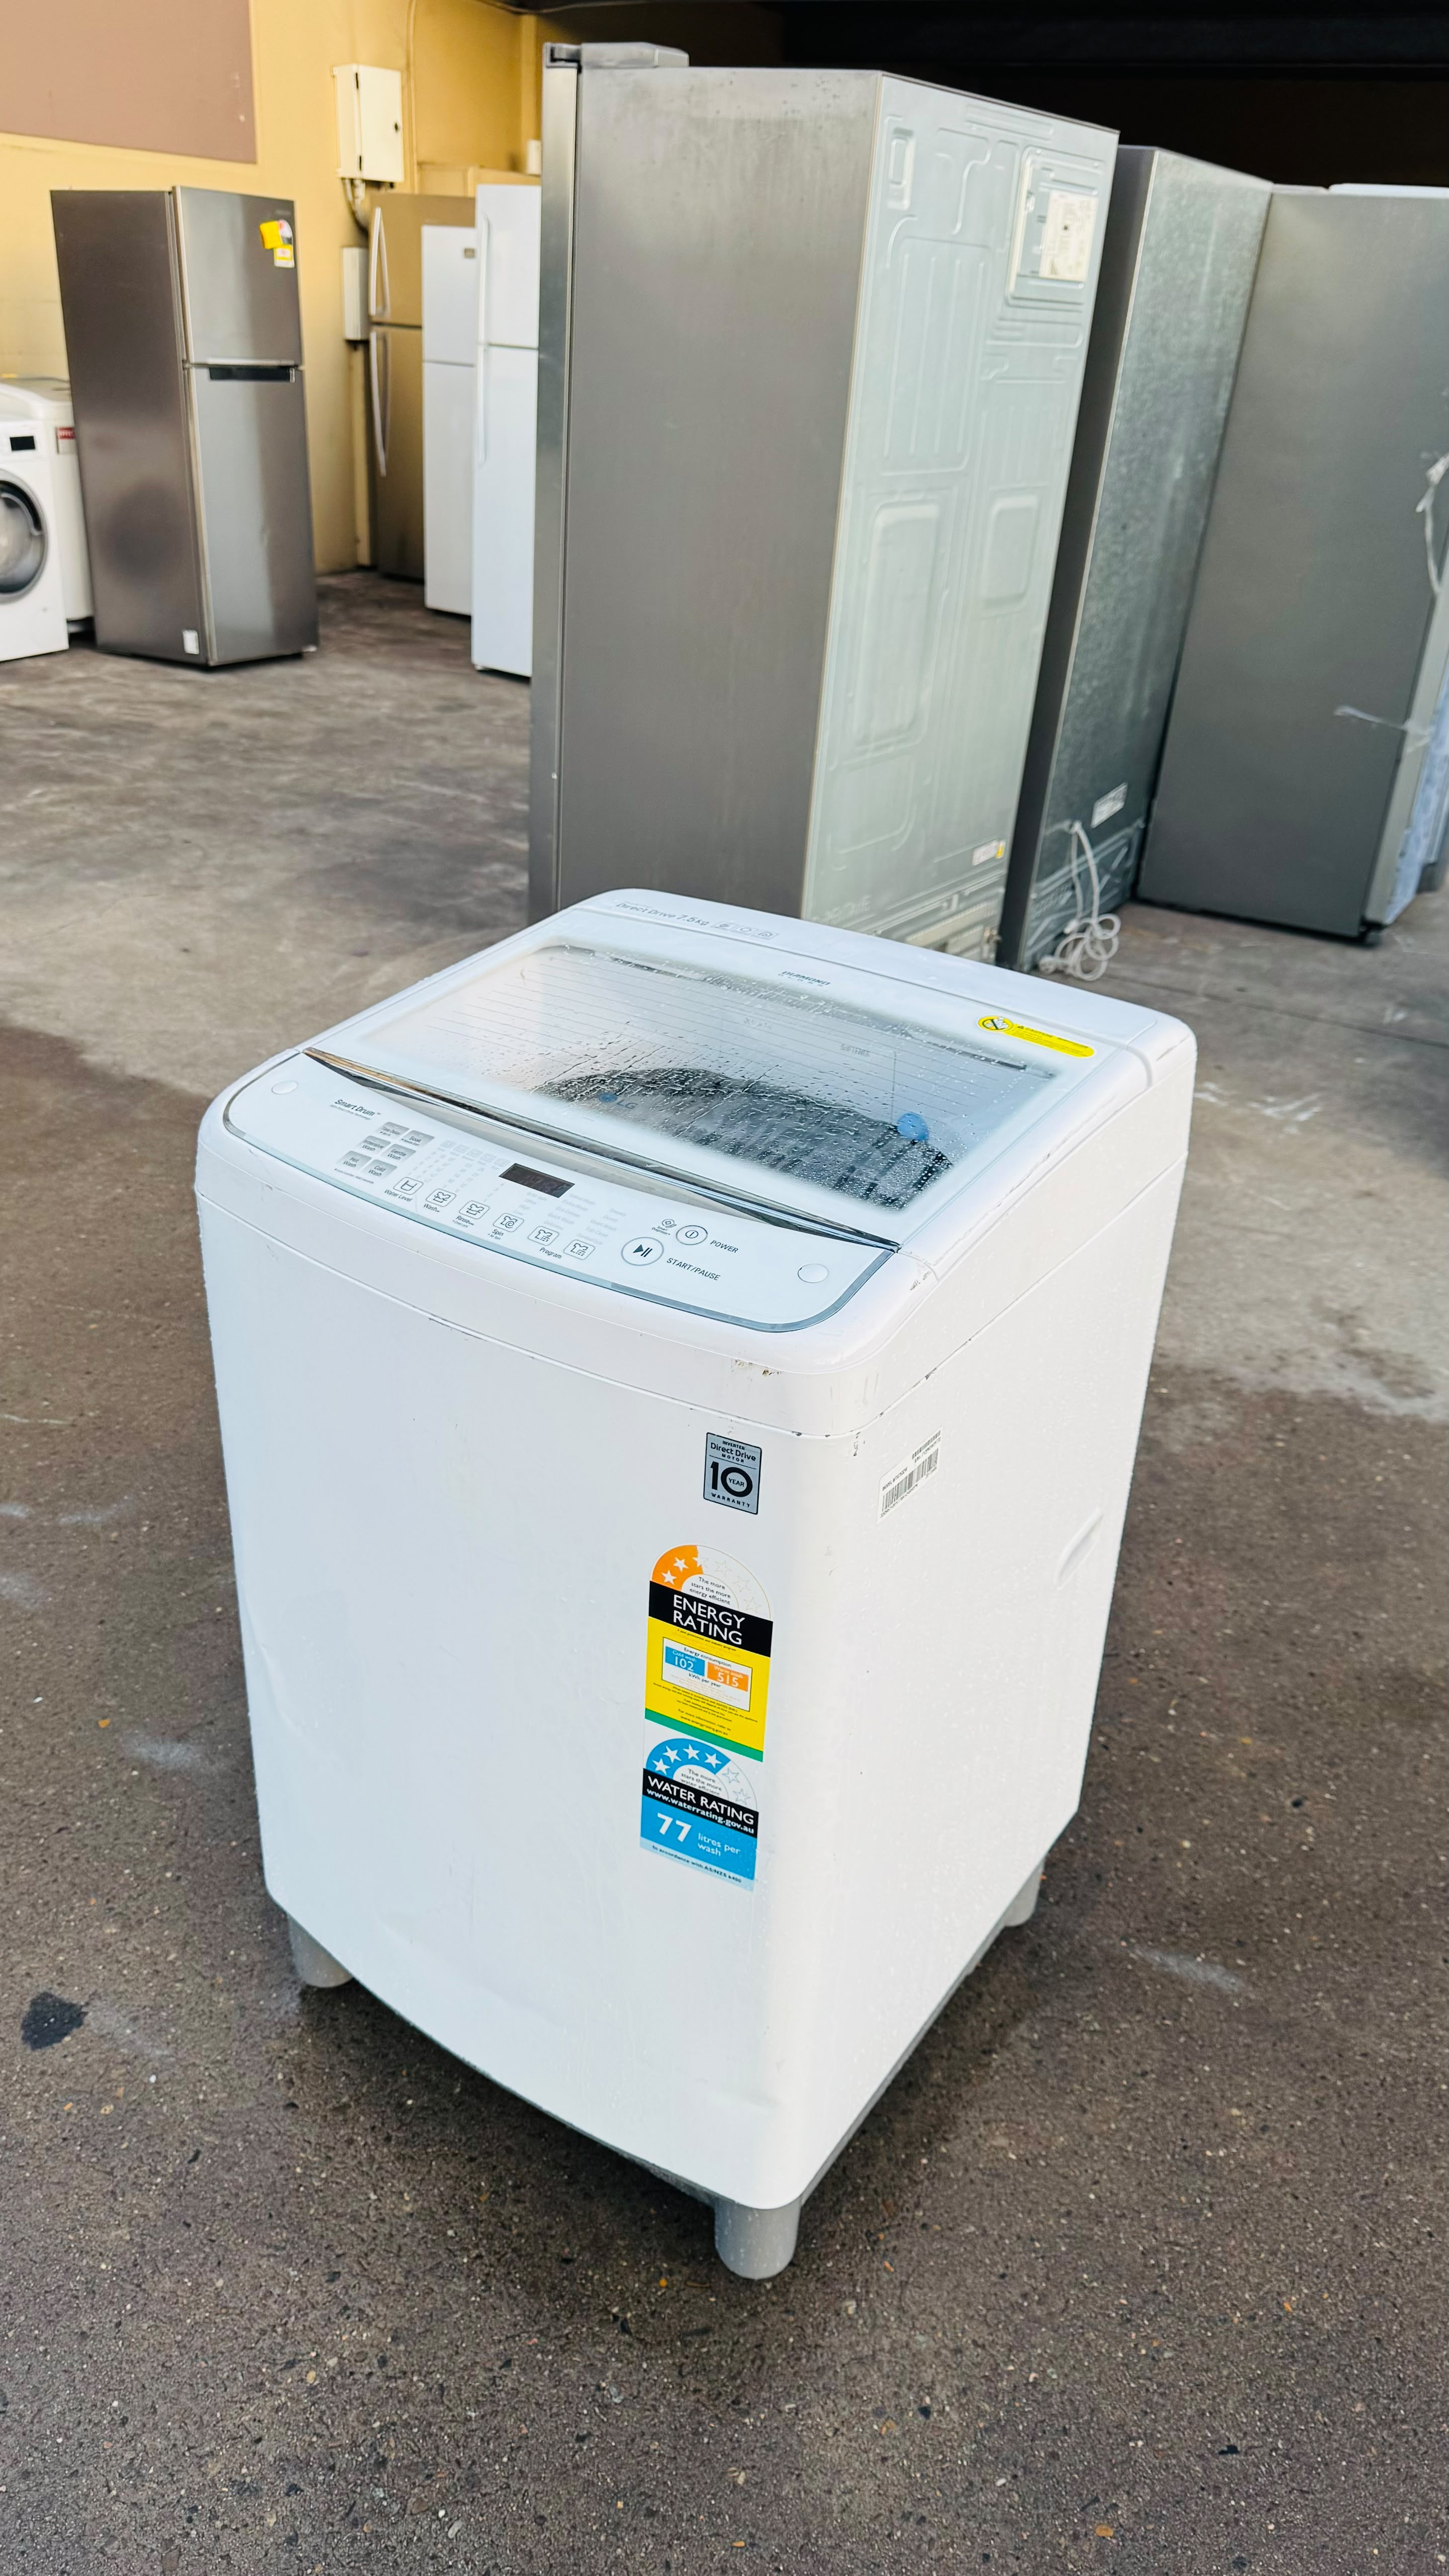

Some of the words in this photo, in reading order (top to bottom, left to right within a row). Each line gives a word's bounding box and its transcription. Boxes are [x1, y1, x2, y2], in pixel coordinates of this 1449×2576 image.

[616, 903, 647, 913] Direct
[649, 909, 676, 918] Drive
[782, 971, 831, 985] DIAMOND
[335, 1099, 357, 1110] Smart
[343, 1160, 357, 1168] Wash
[387, 1153, 401, 1161] Wash
[368, 1169, 382, 1178] Wash
[384, 1188, 399, 1197] Water
[398, 1194, 414, 1202] Level
[539, 1247, 562, 1259] Program
[710, 1240, 739, 1253] POWER
[667, 1258, 721, 1281] START/PAUSE
[710, 1442, 734, 1455] Direct
[736, 1450, 756, 1461] Drive
[722, 1440, 745, 1450] INVERTER
[721, 1454, 744, 1463] MOTOR
[710, 1461, 753, 1497] 10
[729, 1478, 745, 1487] YEAR
[711, 1492, 750, 1508] WARRANTY
[698, 1576, 709, 1584] The
[710, 1582, 726, 1590] more
[689, 1588, 707, 1598] energy
[709, 1594, 731, 1605] efficient
[673, 1594, 745, 1629] ENERGY
[673, 1610, 742, 1645] RATING
[672, 1650, 684, 1658] Cold
[684, 1654, 697, 1662] wash
[684, 1647, 699, 1657] Energy
[700, 1653, 732, 1667] consumption
[675, 1656, 694, 1672] 102
[713, 1664, 730, 1674] Warm
[689, 1673, 700, 1681] kWh
[717, 1672, 739, 1687] 515
[681, 1773, 694, 1782] stars
[706, 1782, 722, 1792] more
[688, 1768, 699, 1777] The
[700, 1774, 716, 1783] more
[648, 1776, 696, 1804] WATER
[700, 1796, 754, 1825] RATING
[647, 1789, 754, 1834] www.waterrating.gov.au
[657, 1812, 692, 1842] 77
[697, 1842, 721, 1857] wash
[698, 1832, 721, 1848] litres
[724, 1844, 741, 1855] per
[659, 1848, 690, 1864] accordance
[704, 1866, 727, 1878] AS/NZS
